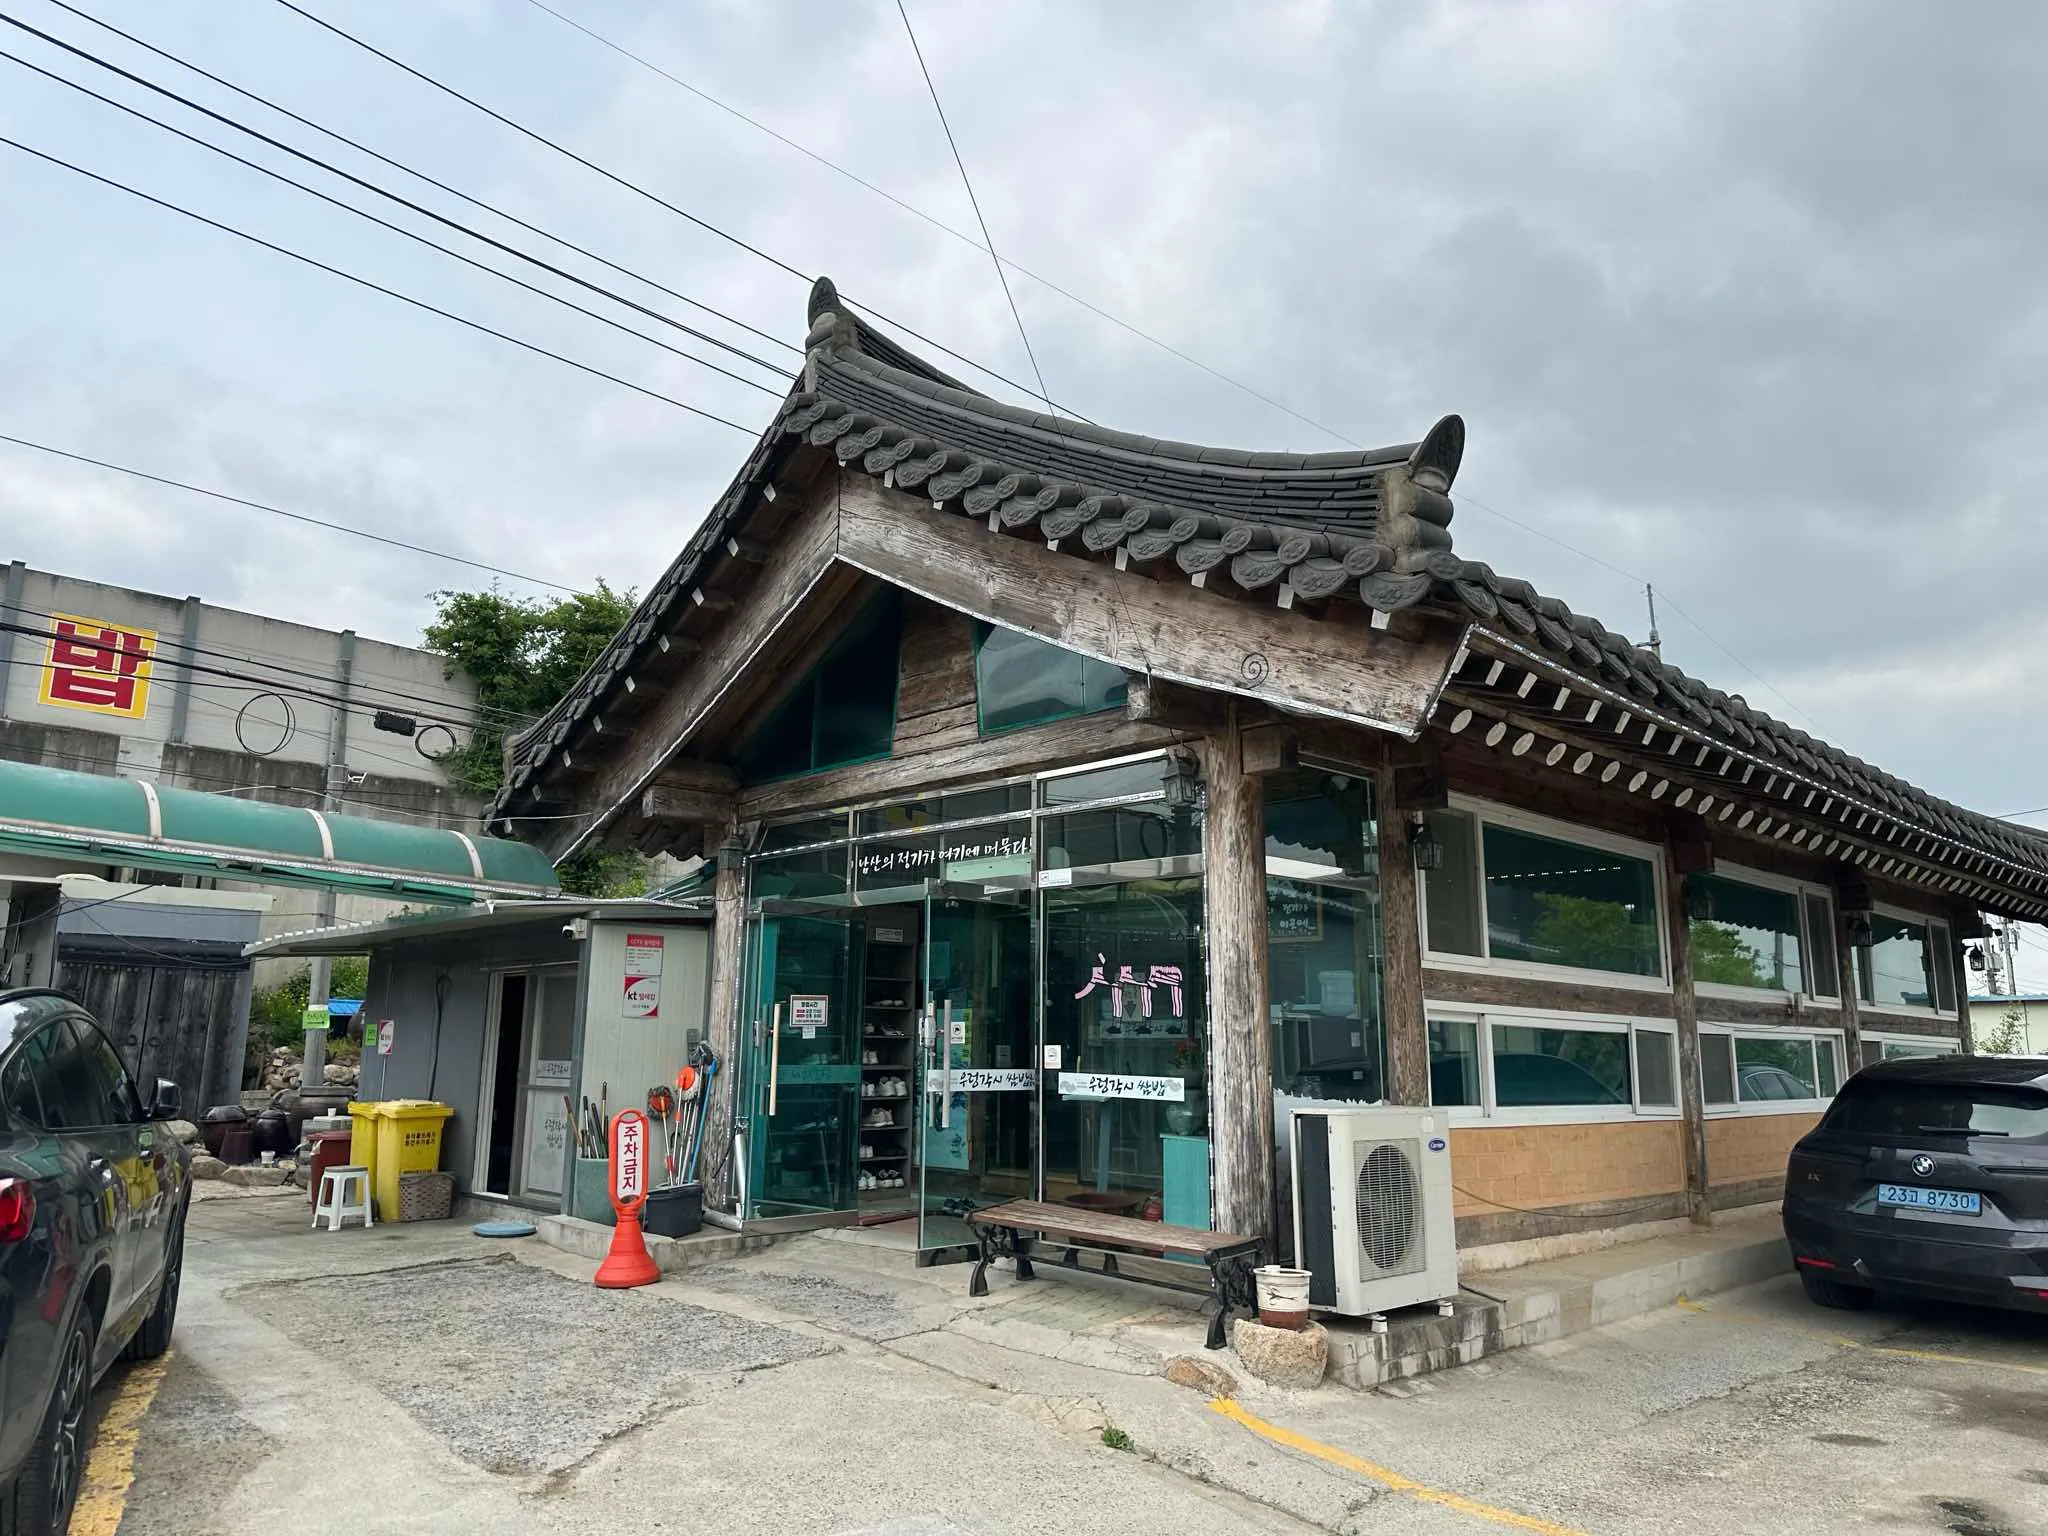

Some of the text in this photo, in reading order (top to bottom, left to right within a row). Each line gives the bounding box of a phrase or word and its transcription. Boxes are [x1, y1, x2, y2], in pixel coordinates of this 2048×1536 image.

[50, 620, 149, 710] 밥
[858, 852, 894, 874] 남산의
[897, 850, 936, 869] 정기가
[938, 844, 981, 861] 여기에
[627, 991, 638, 1001] kt
[960, 1071, 1003, 1089] 우렁각시
[1088, 1076, 1134, 1094] 우렁각시
[1137, 1079, 1166, 1097] 쌈밥
[622, 1125, 639, 1191] 주차금지
[1927, 1190, 1970, 1209] 8730
